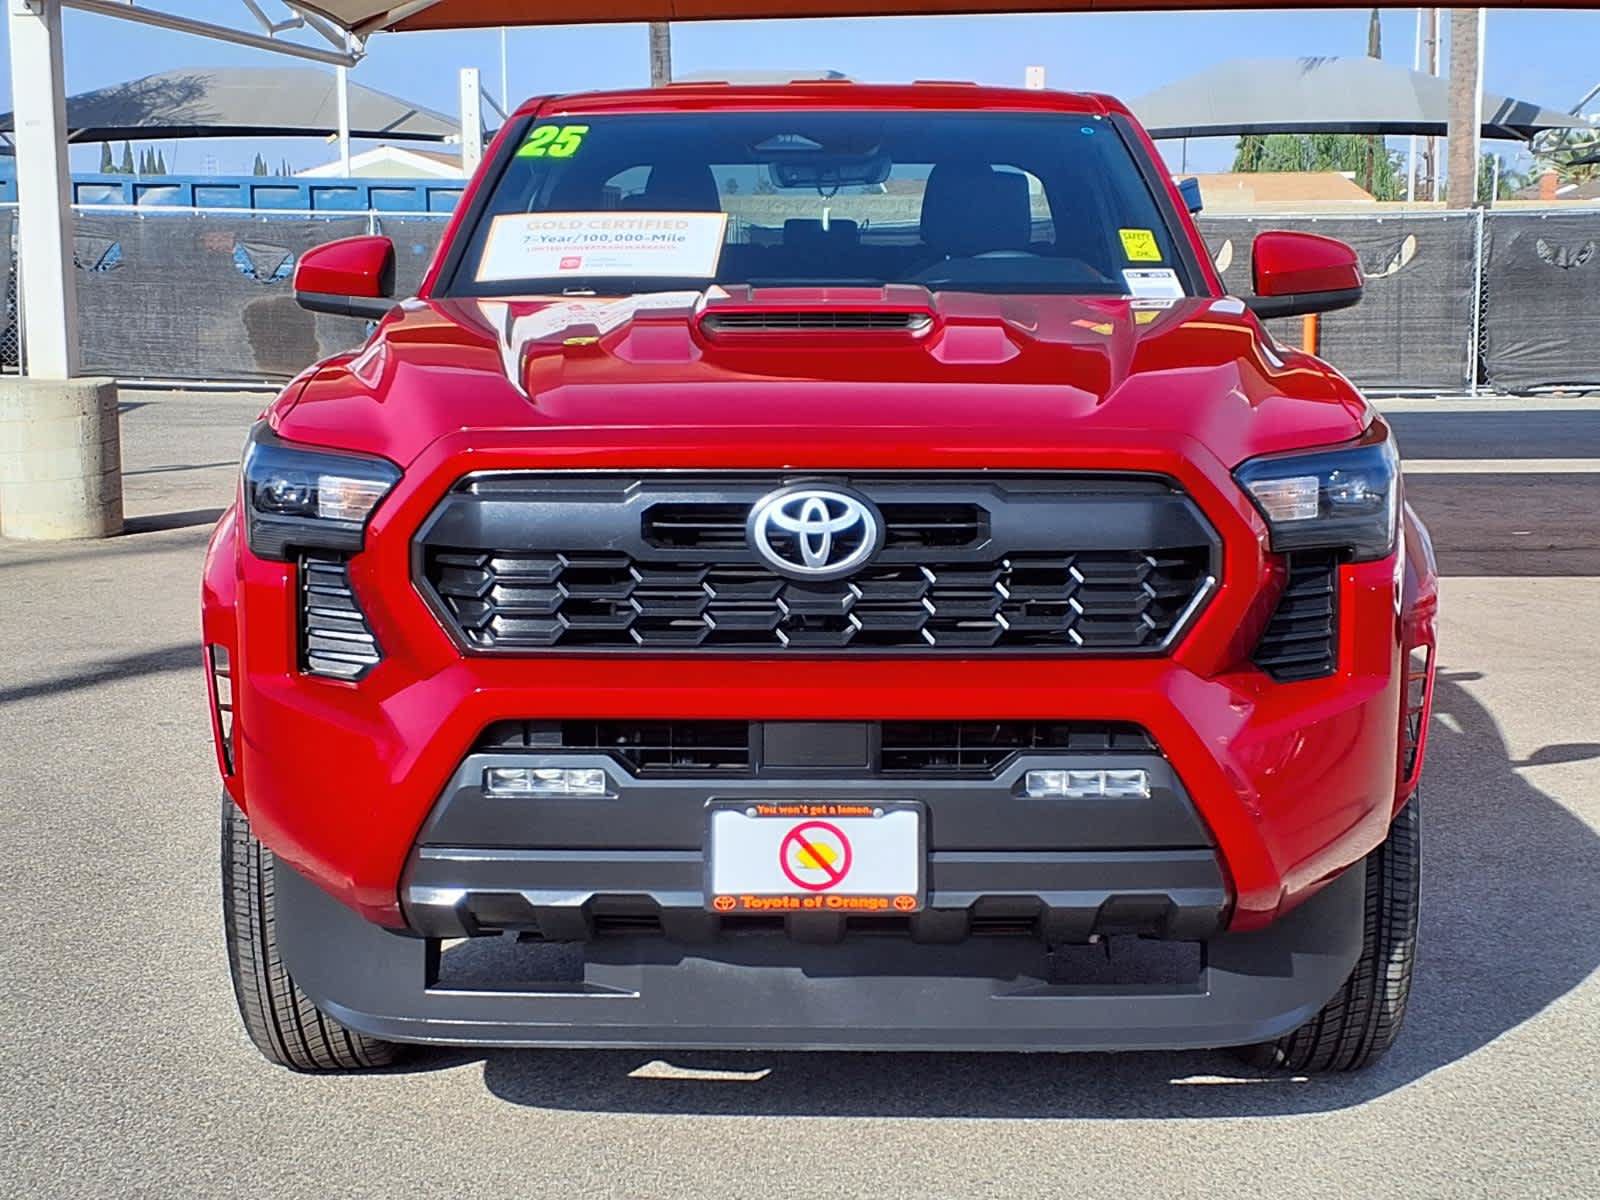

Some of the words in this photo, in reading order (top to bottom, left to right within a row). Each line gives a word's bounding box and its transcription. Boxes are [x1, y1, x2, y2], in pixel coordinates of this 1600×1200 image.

[516, 124, 590, 158] 25
[526, 219, 583, 231] GOLD
[587, 217, 690, 231] CERTIFIED
[757, 804, 777, 814] You
[779, 804, 808, 814] won't
[810, 804, 827, 816] get
[838, 804, 873, 815] lemon.
[740, 895, 800, 910] Toyota
[803, 895, 823, 909] of
[827, 895, 889, 910] Orange
